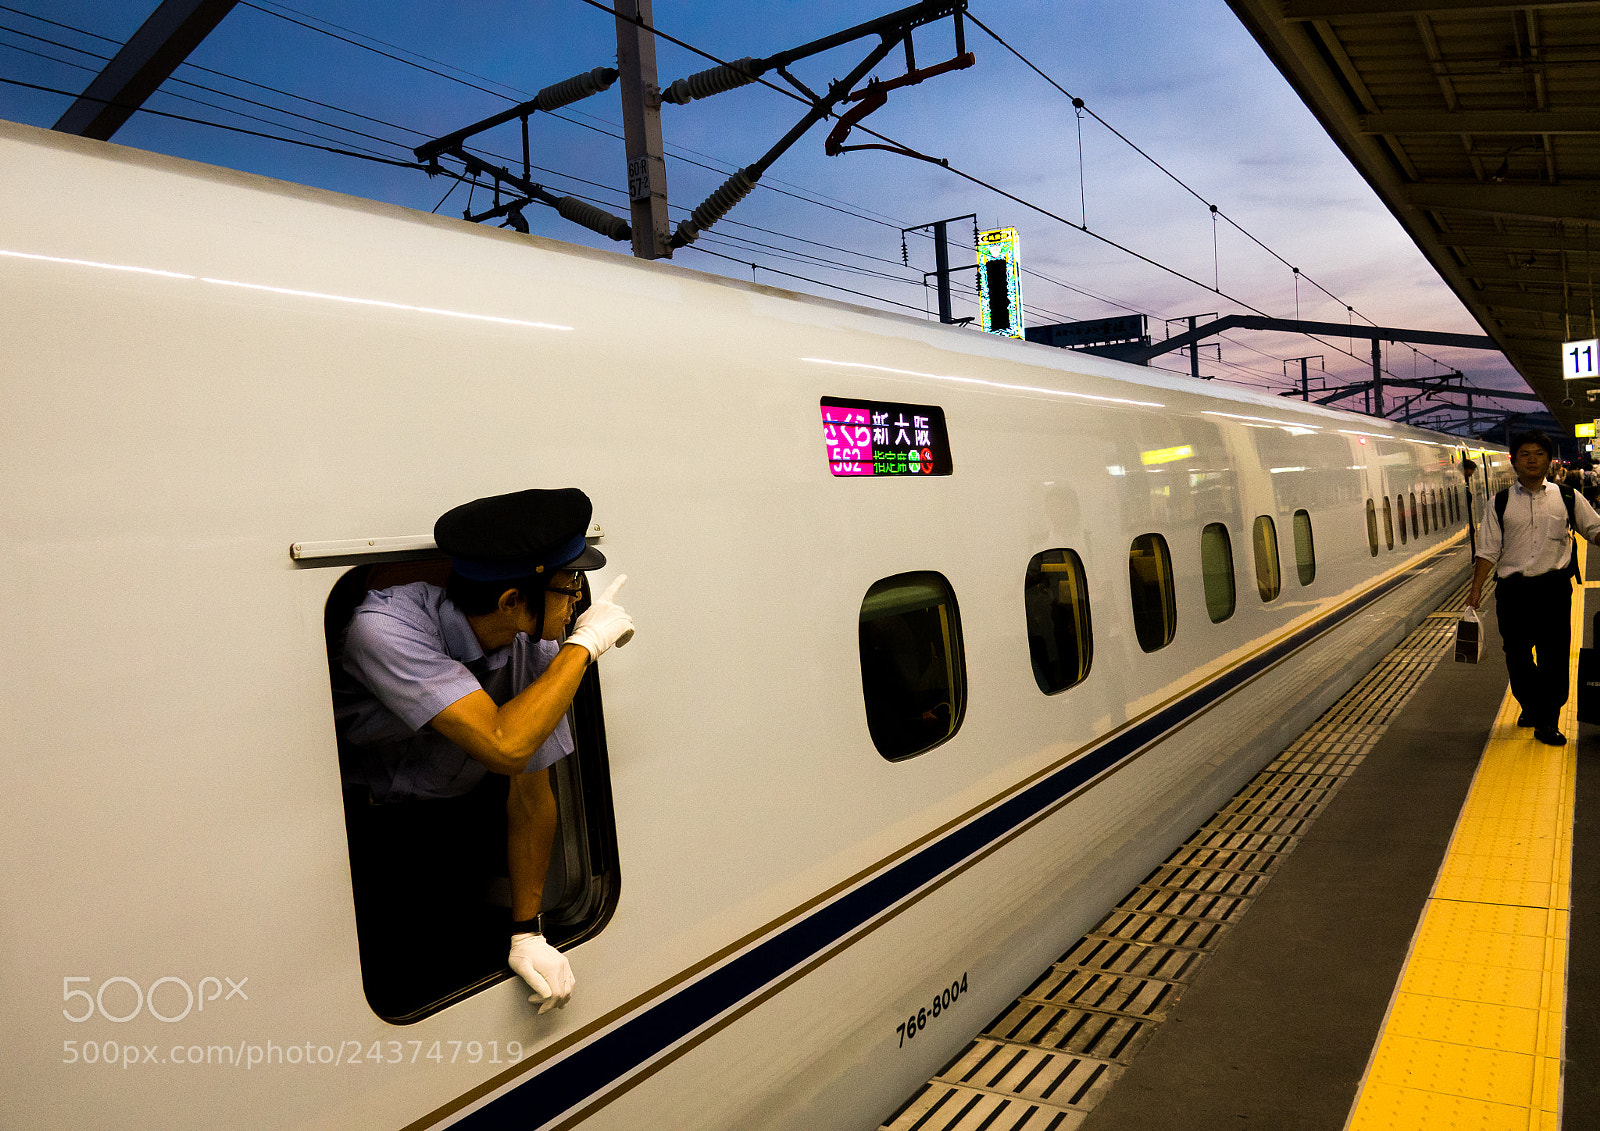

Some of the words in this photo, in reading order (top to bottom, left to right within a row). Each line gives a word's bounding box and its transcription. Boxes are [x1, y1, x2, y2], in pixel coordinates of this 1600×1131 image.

[1569, 345, 1592, 373] 11
[872, 411, 931, 446] 新大阪
[896, 971, 968, 1049] 766-8004
